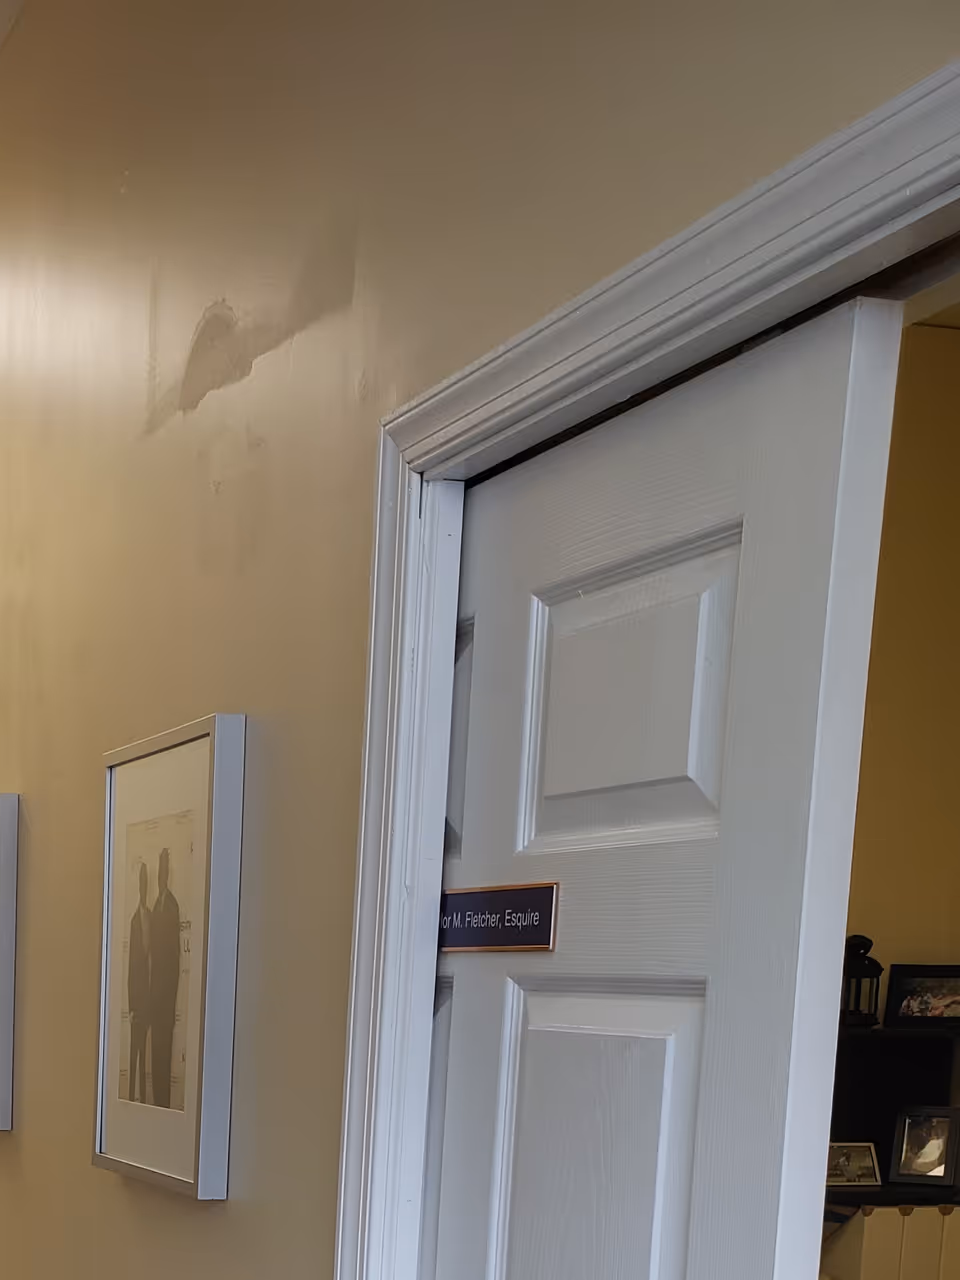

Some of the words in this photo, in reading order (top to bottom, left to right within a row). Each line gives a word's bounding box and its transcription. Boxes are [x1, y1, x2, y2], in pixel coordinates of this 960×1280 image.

[452, 911, 463, 929] M.
[465, 910, 502, 930] Fletcher,
[504, 908, 540, 931] Esquire
